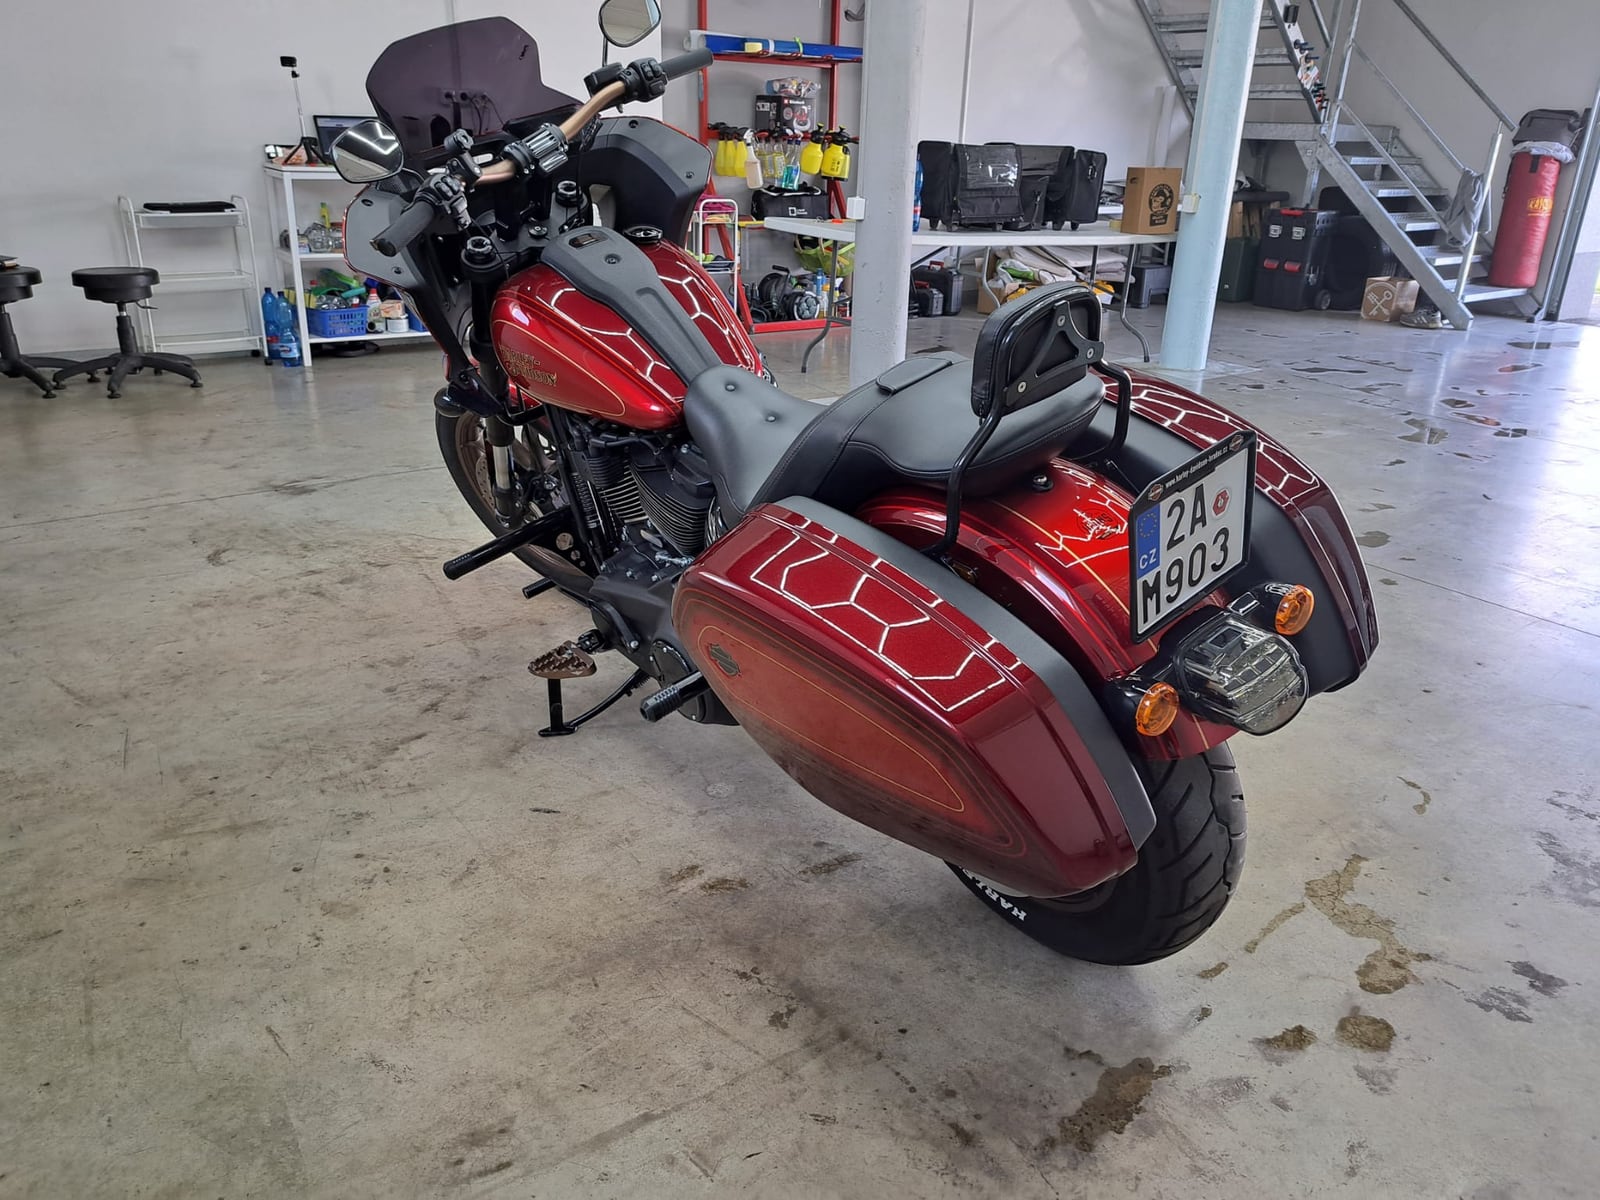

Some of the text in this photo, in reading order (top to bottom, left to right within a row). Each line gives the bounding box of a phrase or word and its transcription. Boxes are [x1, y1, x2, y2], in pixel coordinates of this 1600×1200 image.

[1166, 483, 1207, 551] 2A
[1139, 548, 1157, 570] CZ
[1142, 527, 1229, 624] M903
